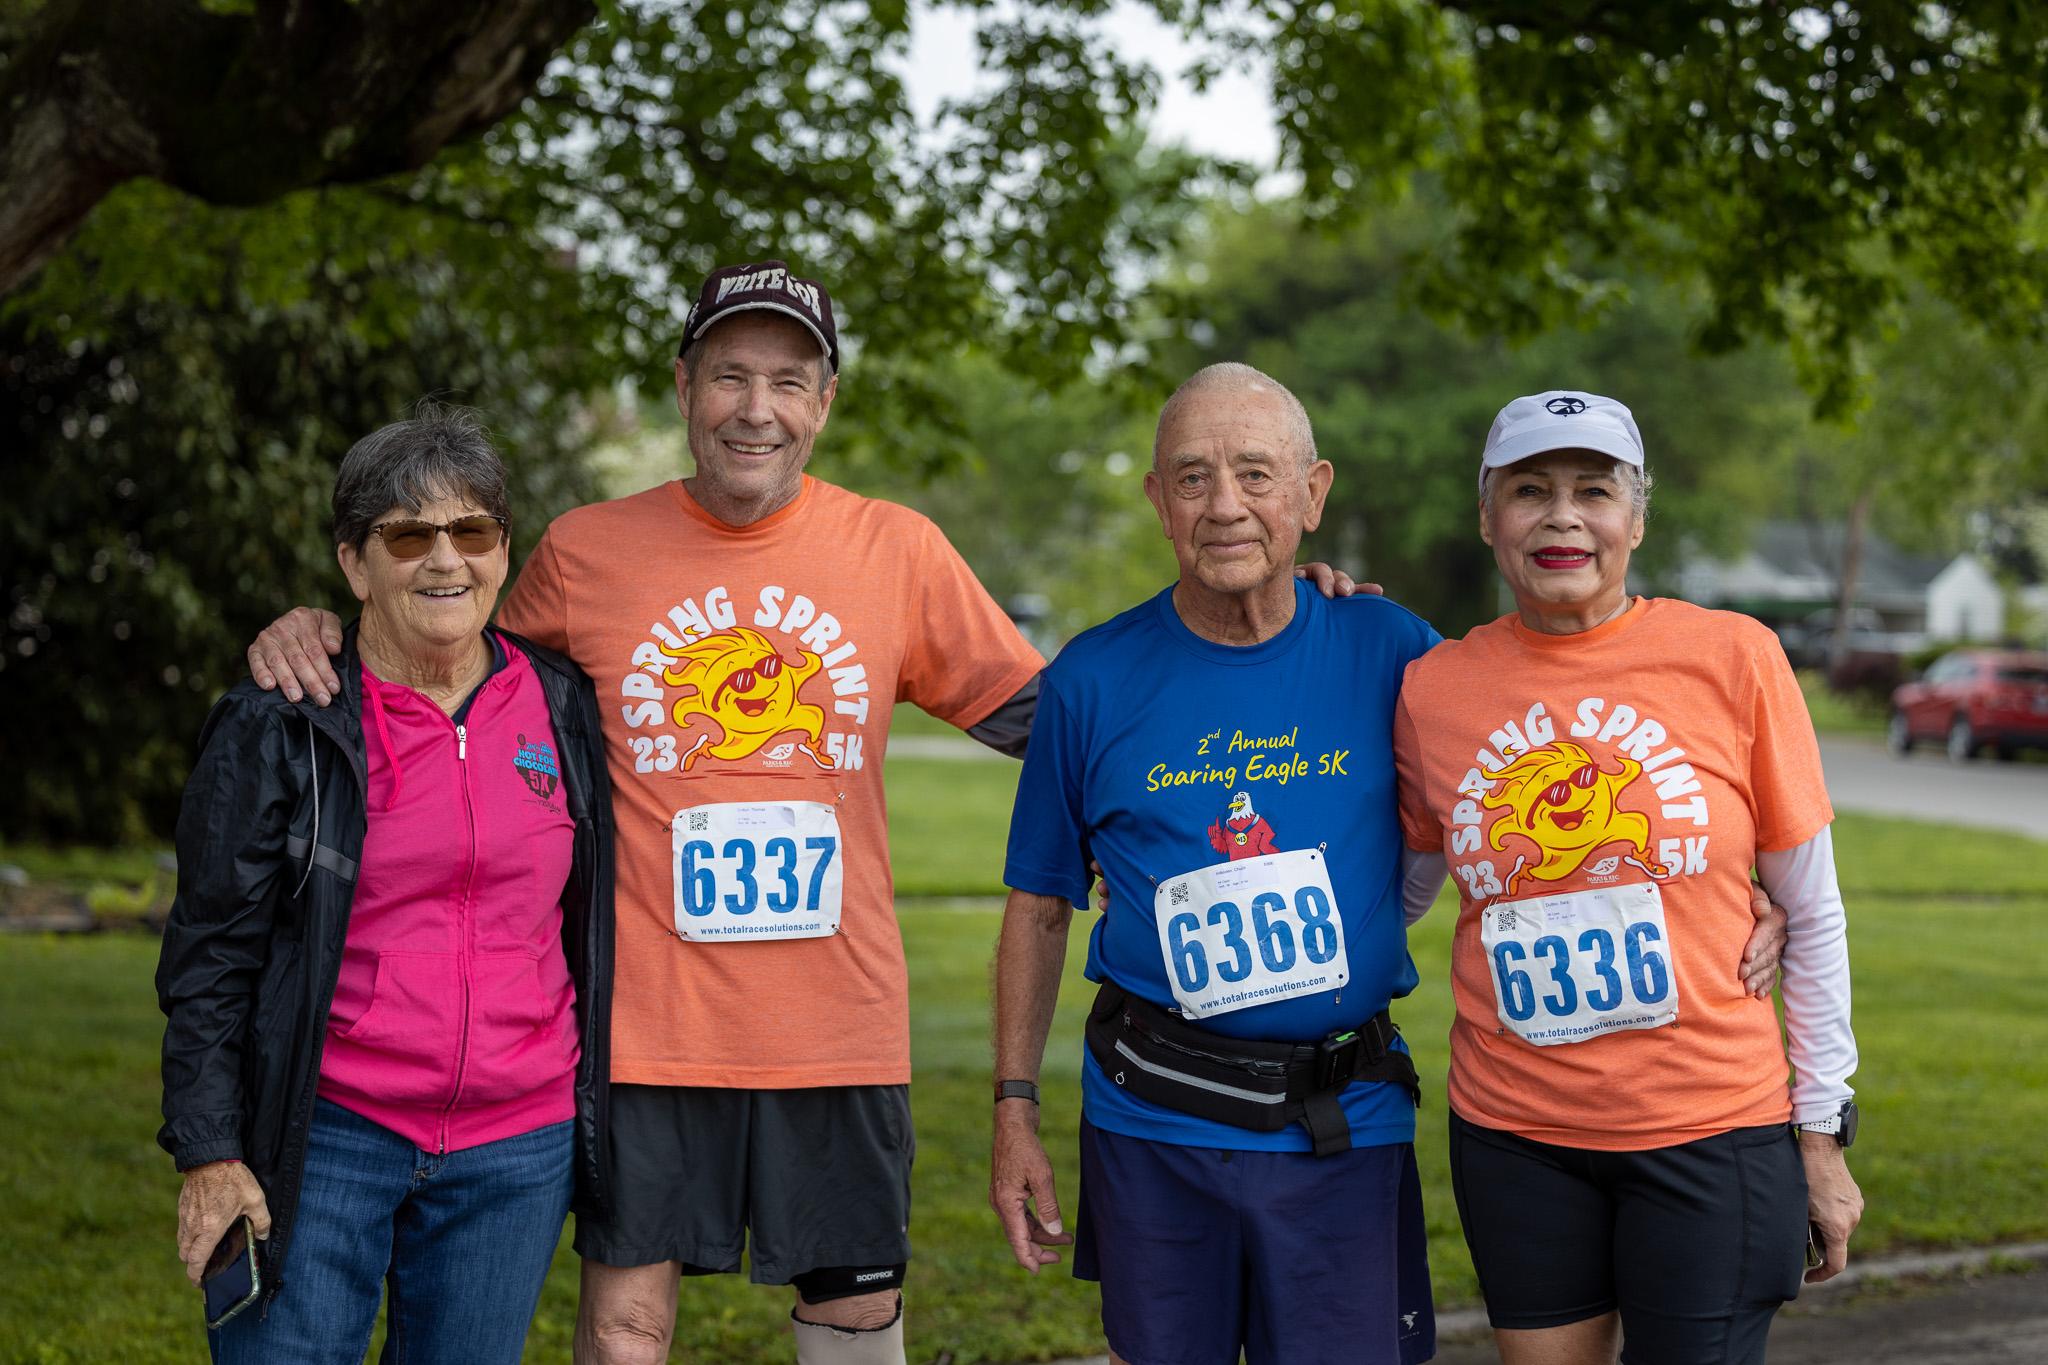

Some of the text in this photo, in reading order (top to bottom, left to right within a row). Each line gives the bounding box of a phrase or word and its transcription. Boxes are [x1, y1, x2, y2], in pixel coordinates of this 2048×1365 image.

[715, 267, 786, 304] WHITE
[621, 585, 869, 728] SPRING SPRINT
[826, 732, 864, 771] 5K
[1197, 726, 1299, 756] 2nd Annual
[1146, 749, 1350, 792] Soaring Eagle 5K
[1452, 697, 1709, 856] SPRING SPRINT
[681, 836, 837, 917] 6337
[1658, 835, 1709, 877] 5K
[700, 922, 821, 936] www.totalracesolutions.com
[1167, 885, 1338, 993] 6368
[1493, 921, 1669, 1022] 6336
[1200, 975, 1327, 1011] www.totalracesolutions.com
[1526, 1014, 1656, 1041] www.totalracesolutions.com
